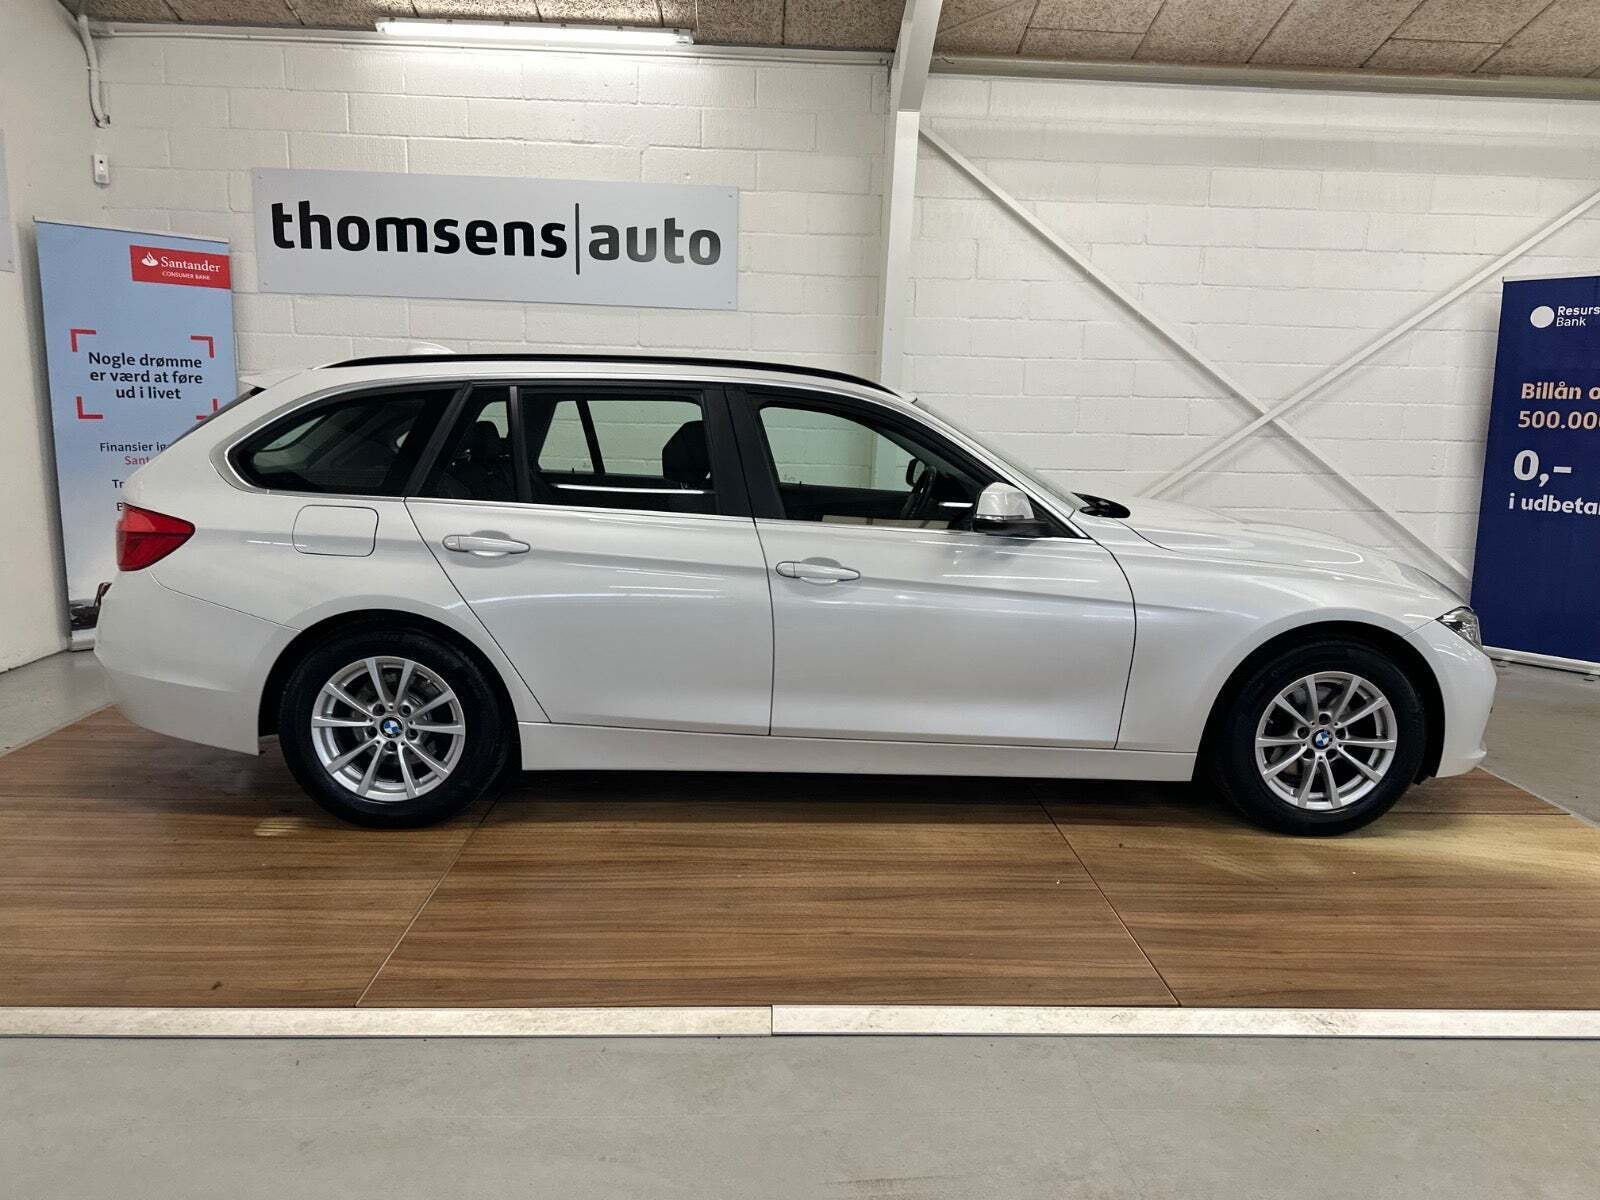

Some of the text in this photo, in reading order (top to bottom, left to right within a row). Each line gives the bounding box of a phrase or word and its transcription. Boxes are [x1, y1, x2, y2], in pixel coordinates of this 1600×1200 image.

[271, 200, 722, 266] thomsens auto
[160, 256, 221, 272] Santander
[161, 271, 211, 281] CONSUMER BANK
[1557, 305, 1600, 316] Resurs
[1556, 316, 1586, 327] Bank
[88, 352, 202, 369] Nogle drømme
[90, 370, 203, 384] er værd at føre
[116, 386, 181, 400] ud i livet
[1521, 380, 1582, 400] Billån
[1518, 410, 1600, 430] 500.00
[100, 442, 153, 453] Finansier
[1508, 492, 1600, 516] i udbeta
